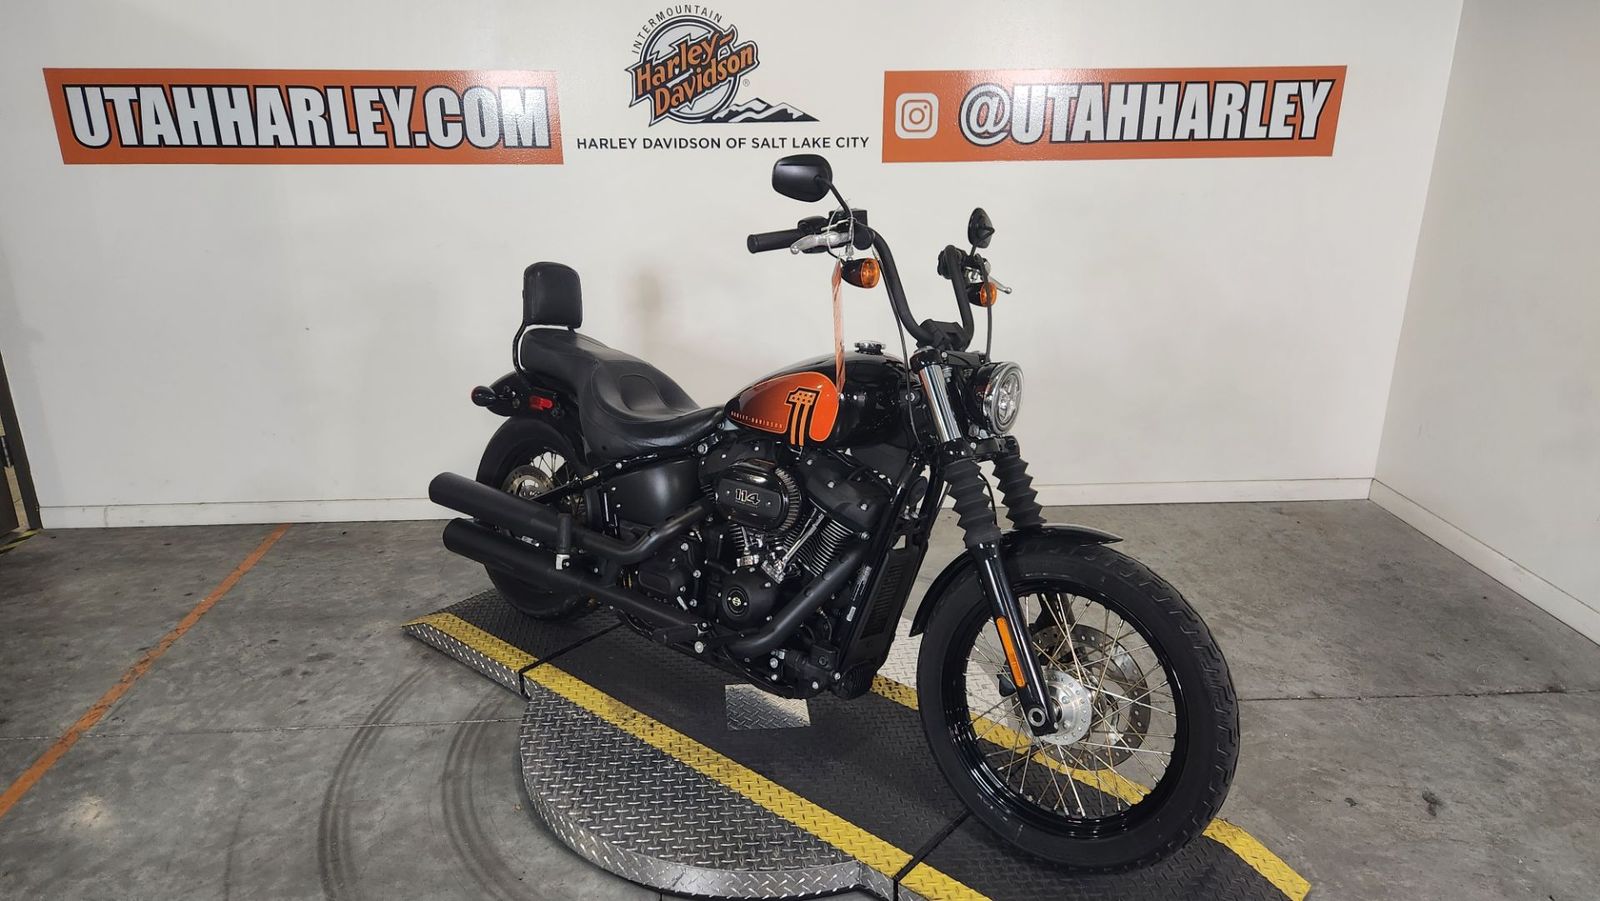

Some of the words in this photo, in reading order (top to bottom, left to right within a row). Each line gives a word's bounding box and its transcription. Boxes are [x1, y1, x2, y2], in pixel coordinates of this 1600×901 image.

[632, 4, 723, 55] INTERMOUNTAIN
[653, 42, 754, 118] Davidson
[62, 84, 552, 150] UTAHHARLEY.COM
[958, 79, 1337, 147] @UTAHHARLEY
[576, 137, 638, 150] HARLEY
[643, 137, 720, 149] DAVIDSON
[726, 137, 747, 149] OF
[751, 136, 786, 149] SALT
[792, 136, 831, 149] LAKE
[835, 136, 870, 149] CITY
[735, 488, 761, 506] 114
